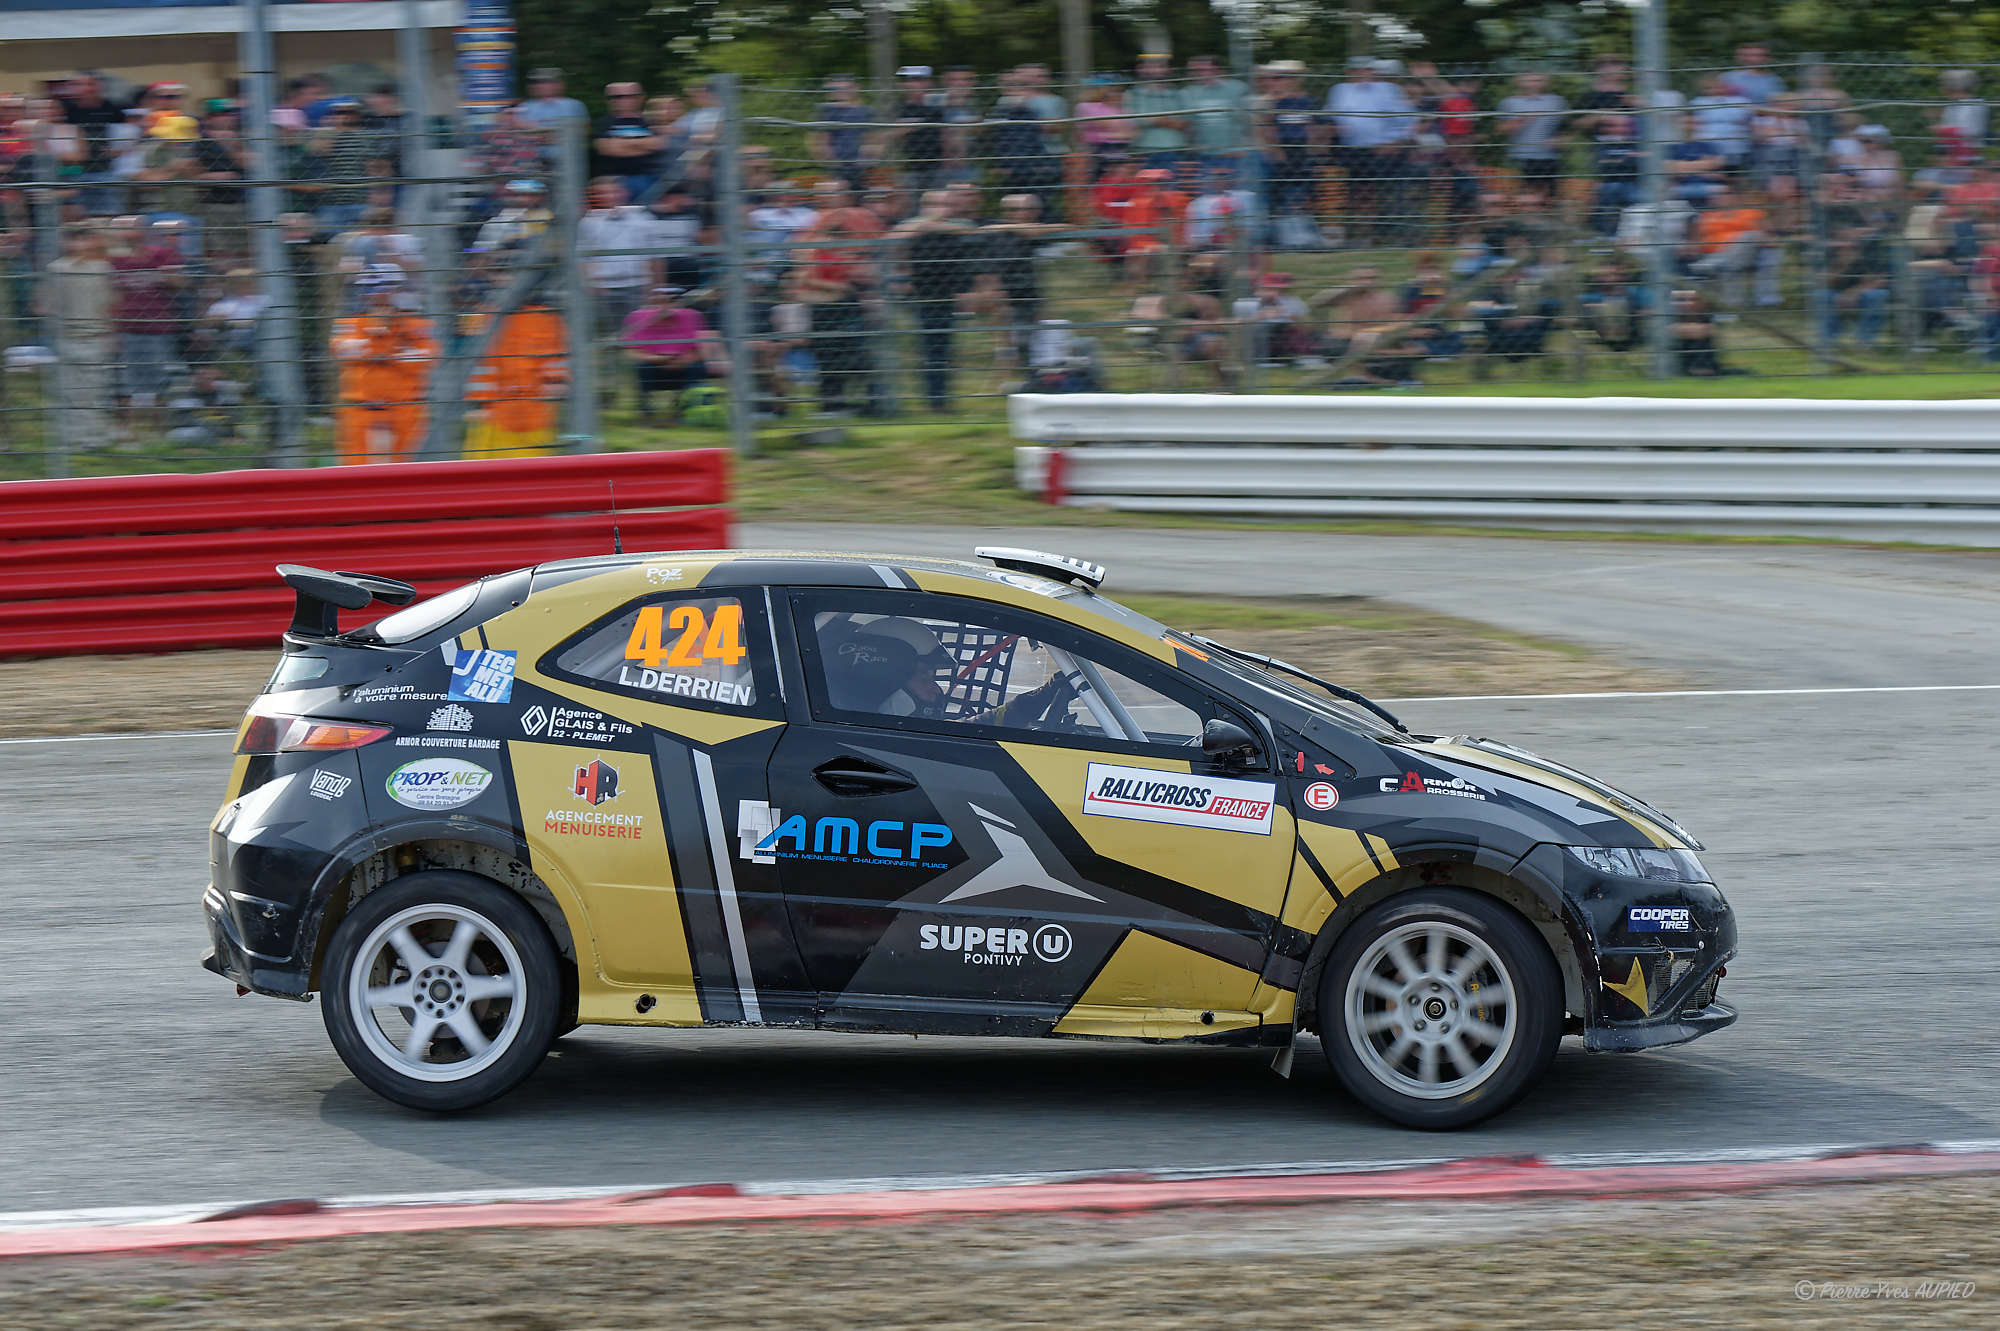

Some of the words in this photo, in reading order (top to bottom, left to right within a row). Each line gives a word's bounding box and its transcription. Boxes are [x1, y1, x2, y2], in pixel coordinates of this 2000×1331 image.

[646, 568, 682, 578] POZ
[625, 605, 746, 667] 424
[479, 650, 516, 674] TEC
[473, 665, 514, 691] MET
[618, 666, 751, 706] L.DERRIEN
[365, 692, 397, 702] votre
[400, 692, 448, 701] mesure
[464, 681, 503, 704] ALU
[556, 707, 602, 720] Agence
[555, 718, 594, 730] GLAIS
[598, 722, 607, 731] &
[610, 723, 633, 734] Fils
[396, 736, 420, 747] ARMOR
[421, 738, 467, 748] COUVERTURE
[468, 738, 500, 749] BARDAGE
[552, 730, 565, 738] 22
[572, 732, 615, 742] PLEMET
[450, 771, 490, 785] NET
[1098, 777, 1212, 808] RALLYCROSS
[1314, 789, 1329, 805] E
[1211, 798, 1267, 819] FRANCE
[545, 809, 643, 826] AGENCEMENT
[544, 820, 643, 840] MENUISERIE
[754, 814, 953, 859] AMCP
[1630, 908, 1689, 920] COOPER
[1660, 920, 1689, 930] TIRES
[920, 924, 1028, 954] SUPER
[964, 952, 1022, 966] PONTIVY
